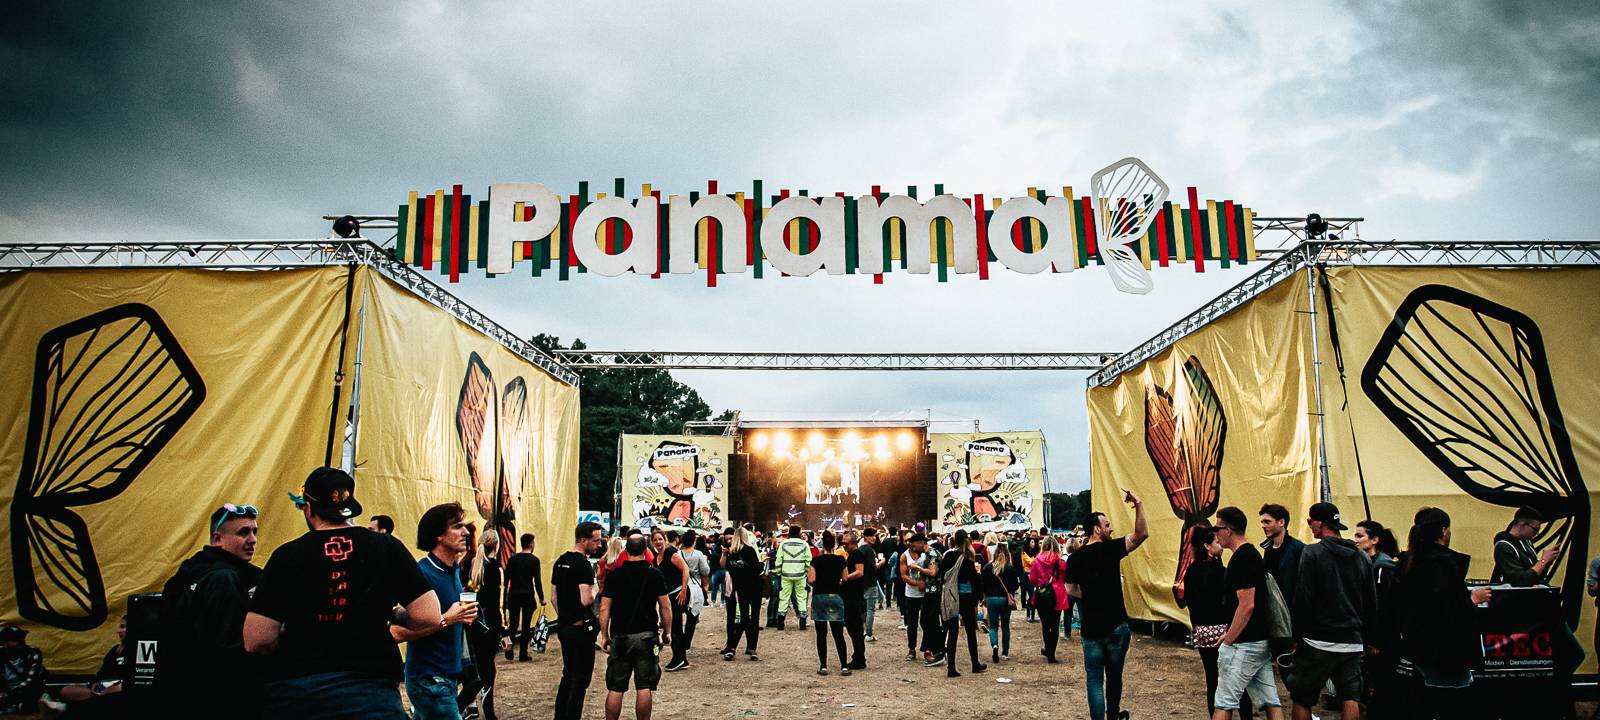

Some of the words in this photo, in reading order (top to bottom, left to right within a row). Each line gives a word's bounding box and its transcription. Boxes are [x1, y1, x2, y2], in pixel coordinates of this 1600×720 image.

[487, 183, 1075, 276] Panama
[657, 447, 697, 457] Panama
[967, 442, 1005, 453] Panama
